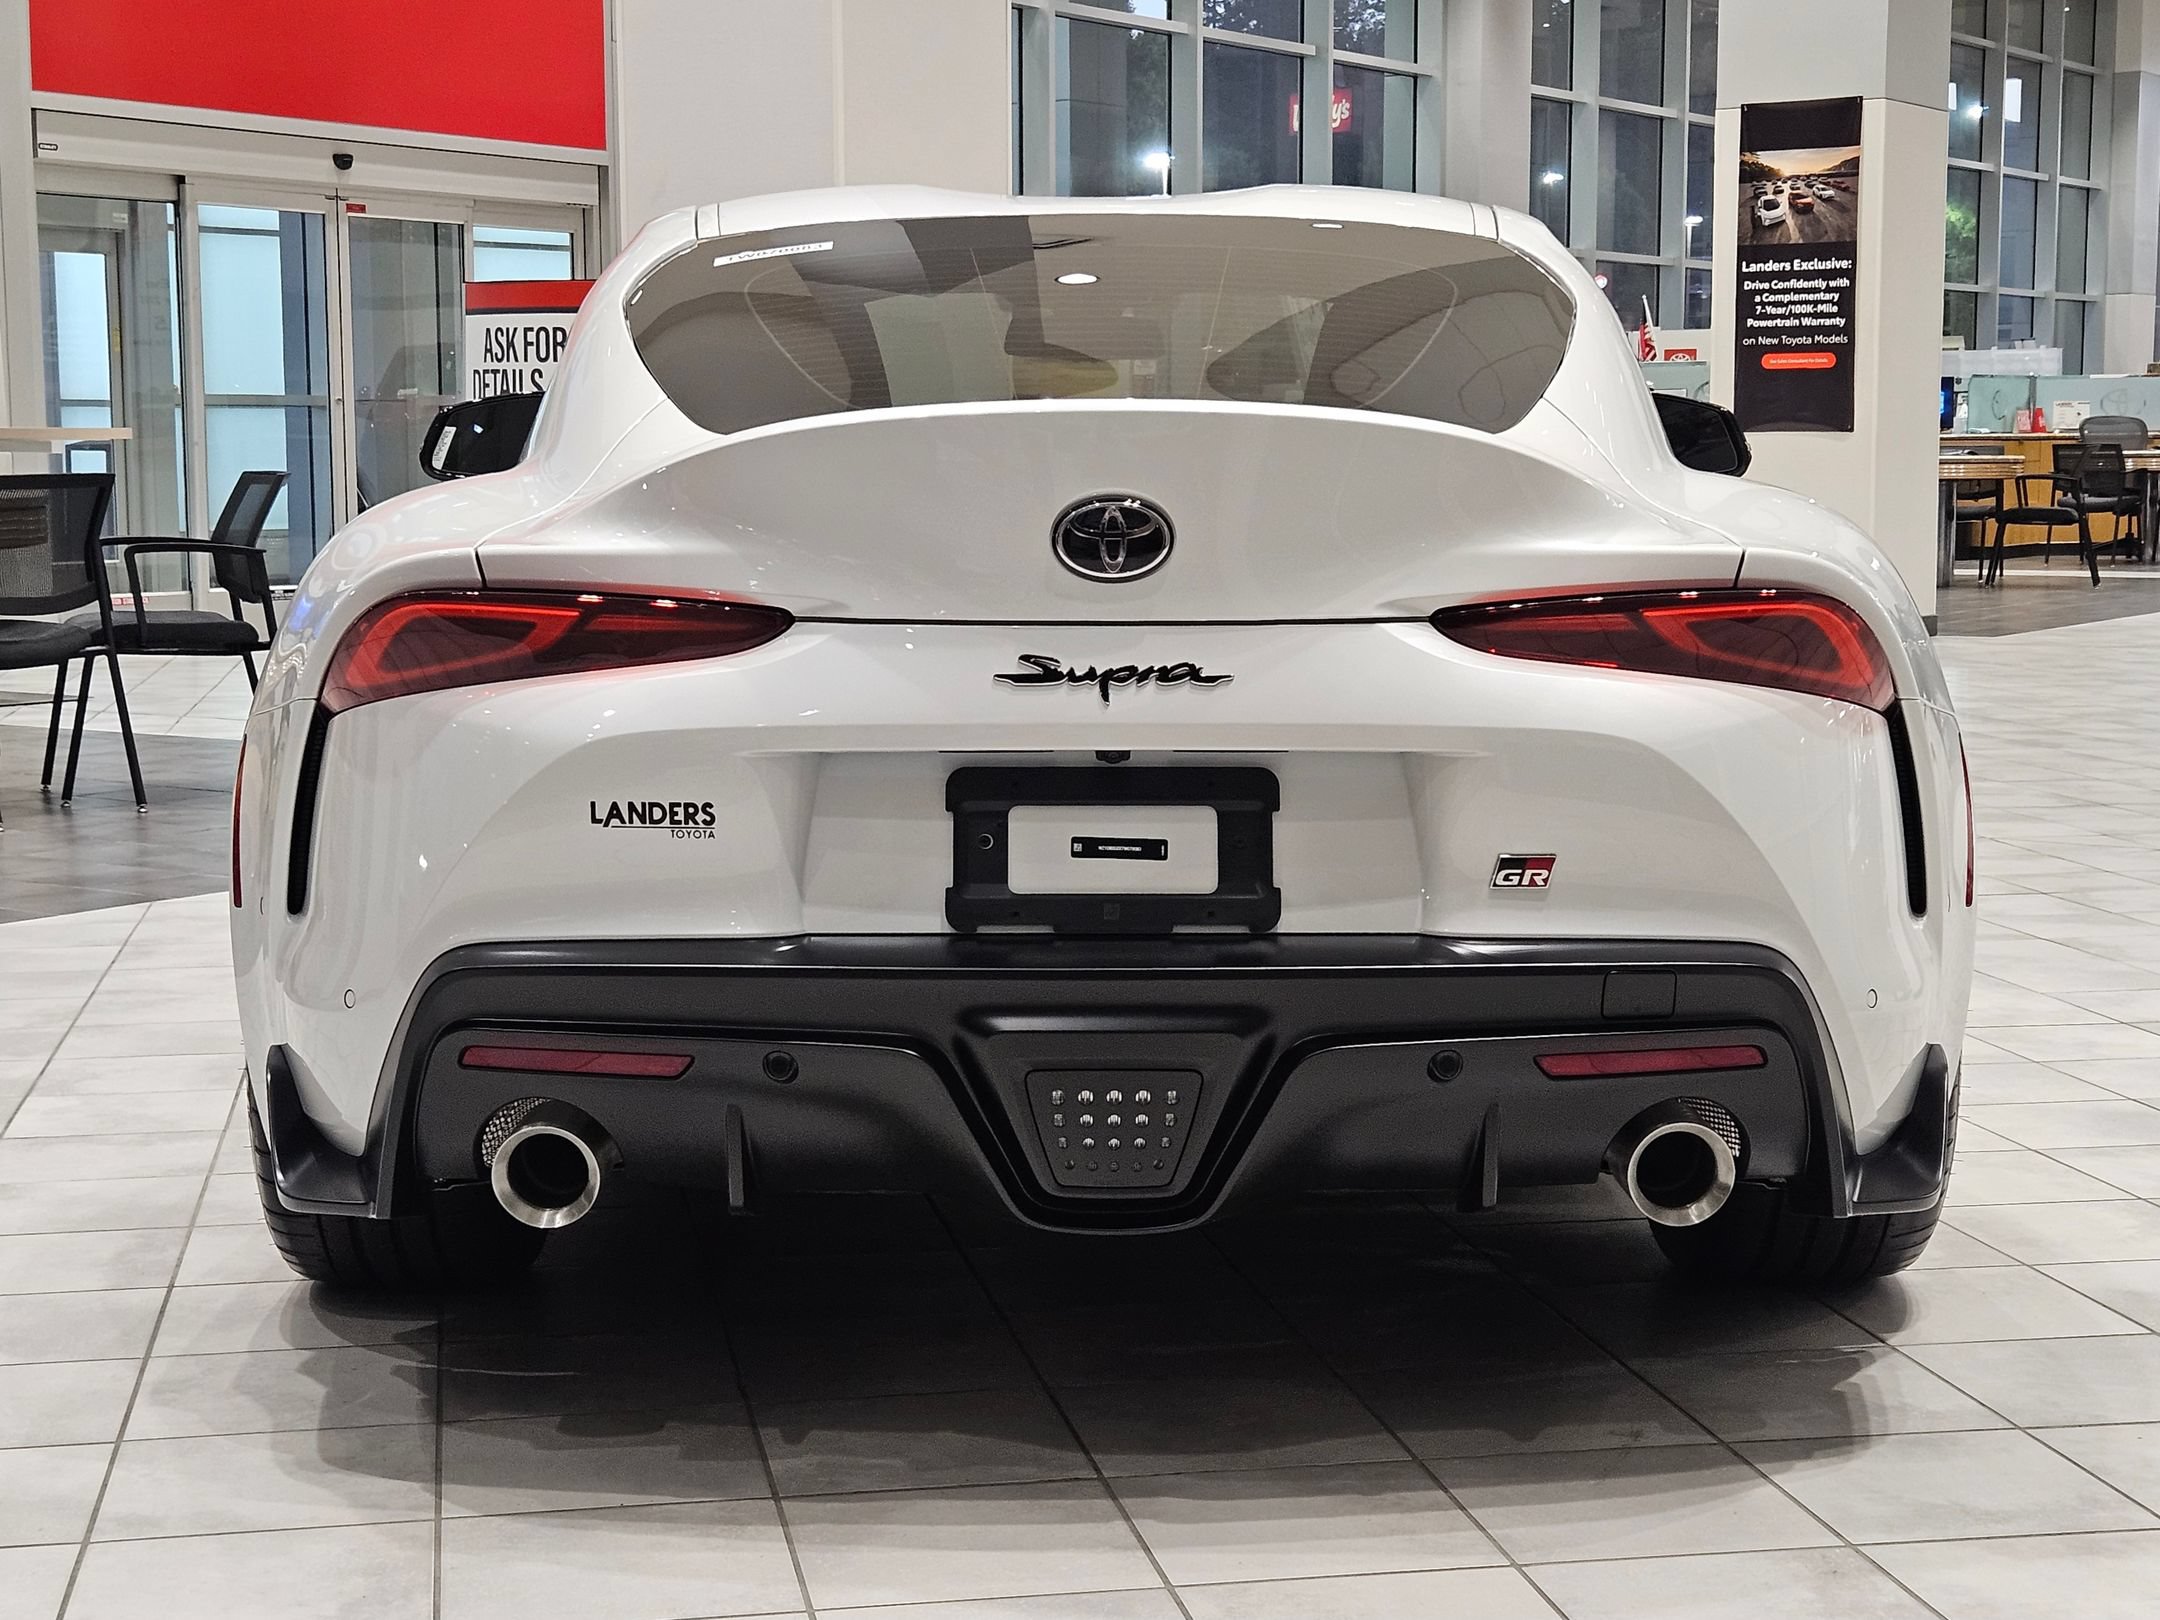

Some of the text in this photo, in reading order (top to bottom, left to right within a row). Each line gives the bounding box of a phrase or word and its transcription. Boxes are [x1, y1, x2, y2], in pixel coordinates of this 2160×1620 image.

[1742, 257, 1852, 273] Landers Exclusive:
[1743, 277, 1850, 290] Drive Confidently with
[1754, 291, 1840, 303] a Complementary
[1755, 303, 1839, 315] 7-Year/100K-Mile
[1746, 316, 1846, 328] Powertrain Warranty
[483, 326, 568, 363] ASK FOR
[1742, 333, 1849, 347] on New Toyota Models
[993, 653, 1235, 706] Supra
[590, 800, 716, 828] LANDERS
[670, 829, 716, 839] TOYOTA
[1495, 869, 1549, 886] GR
